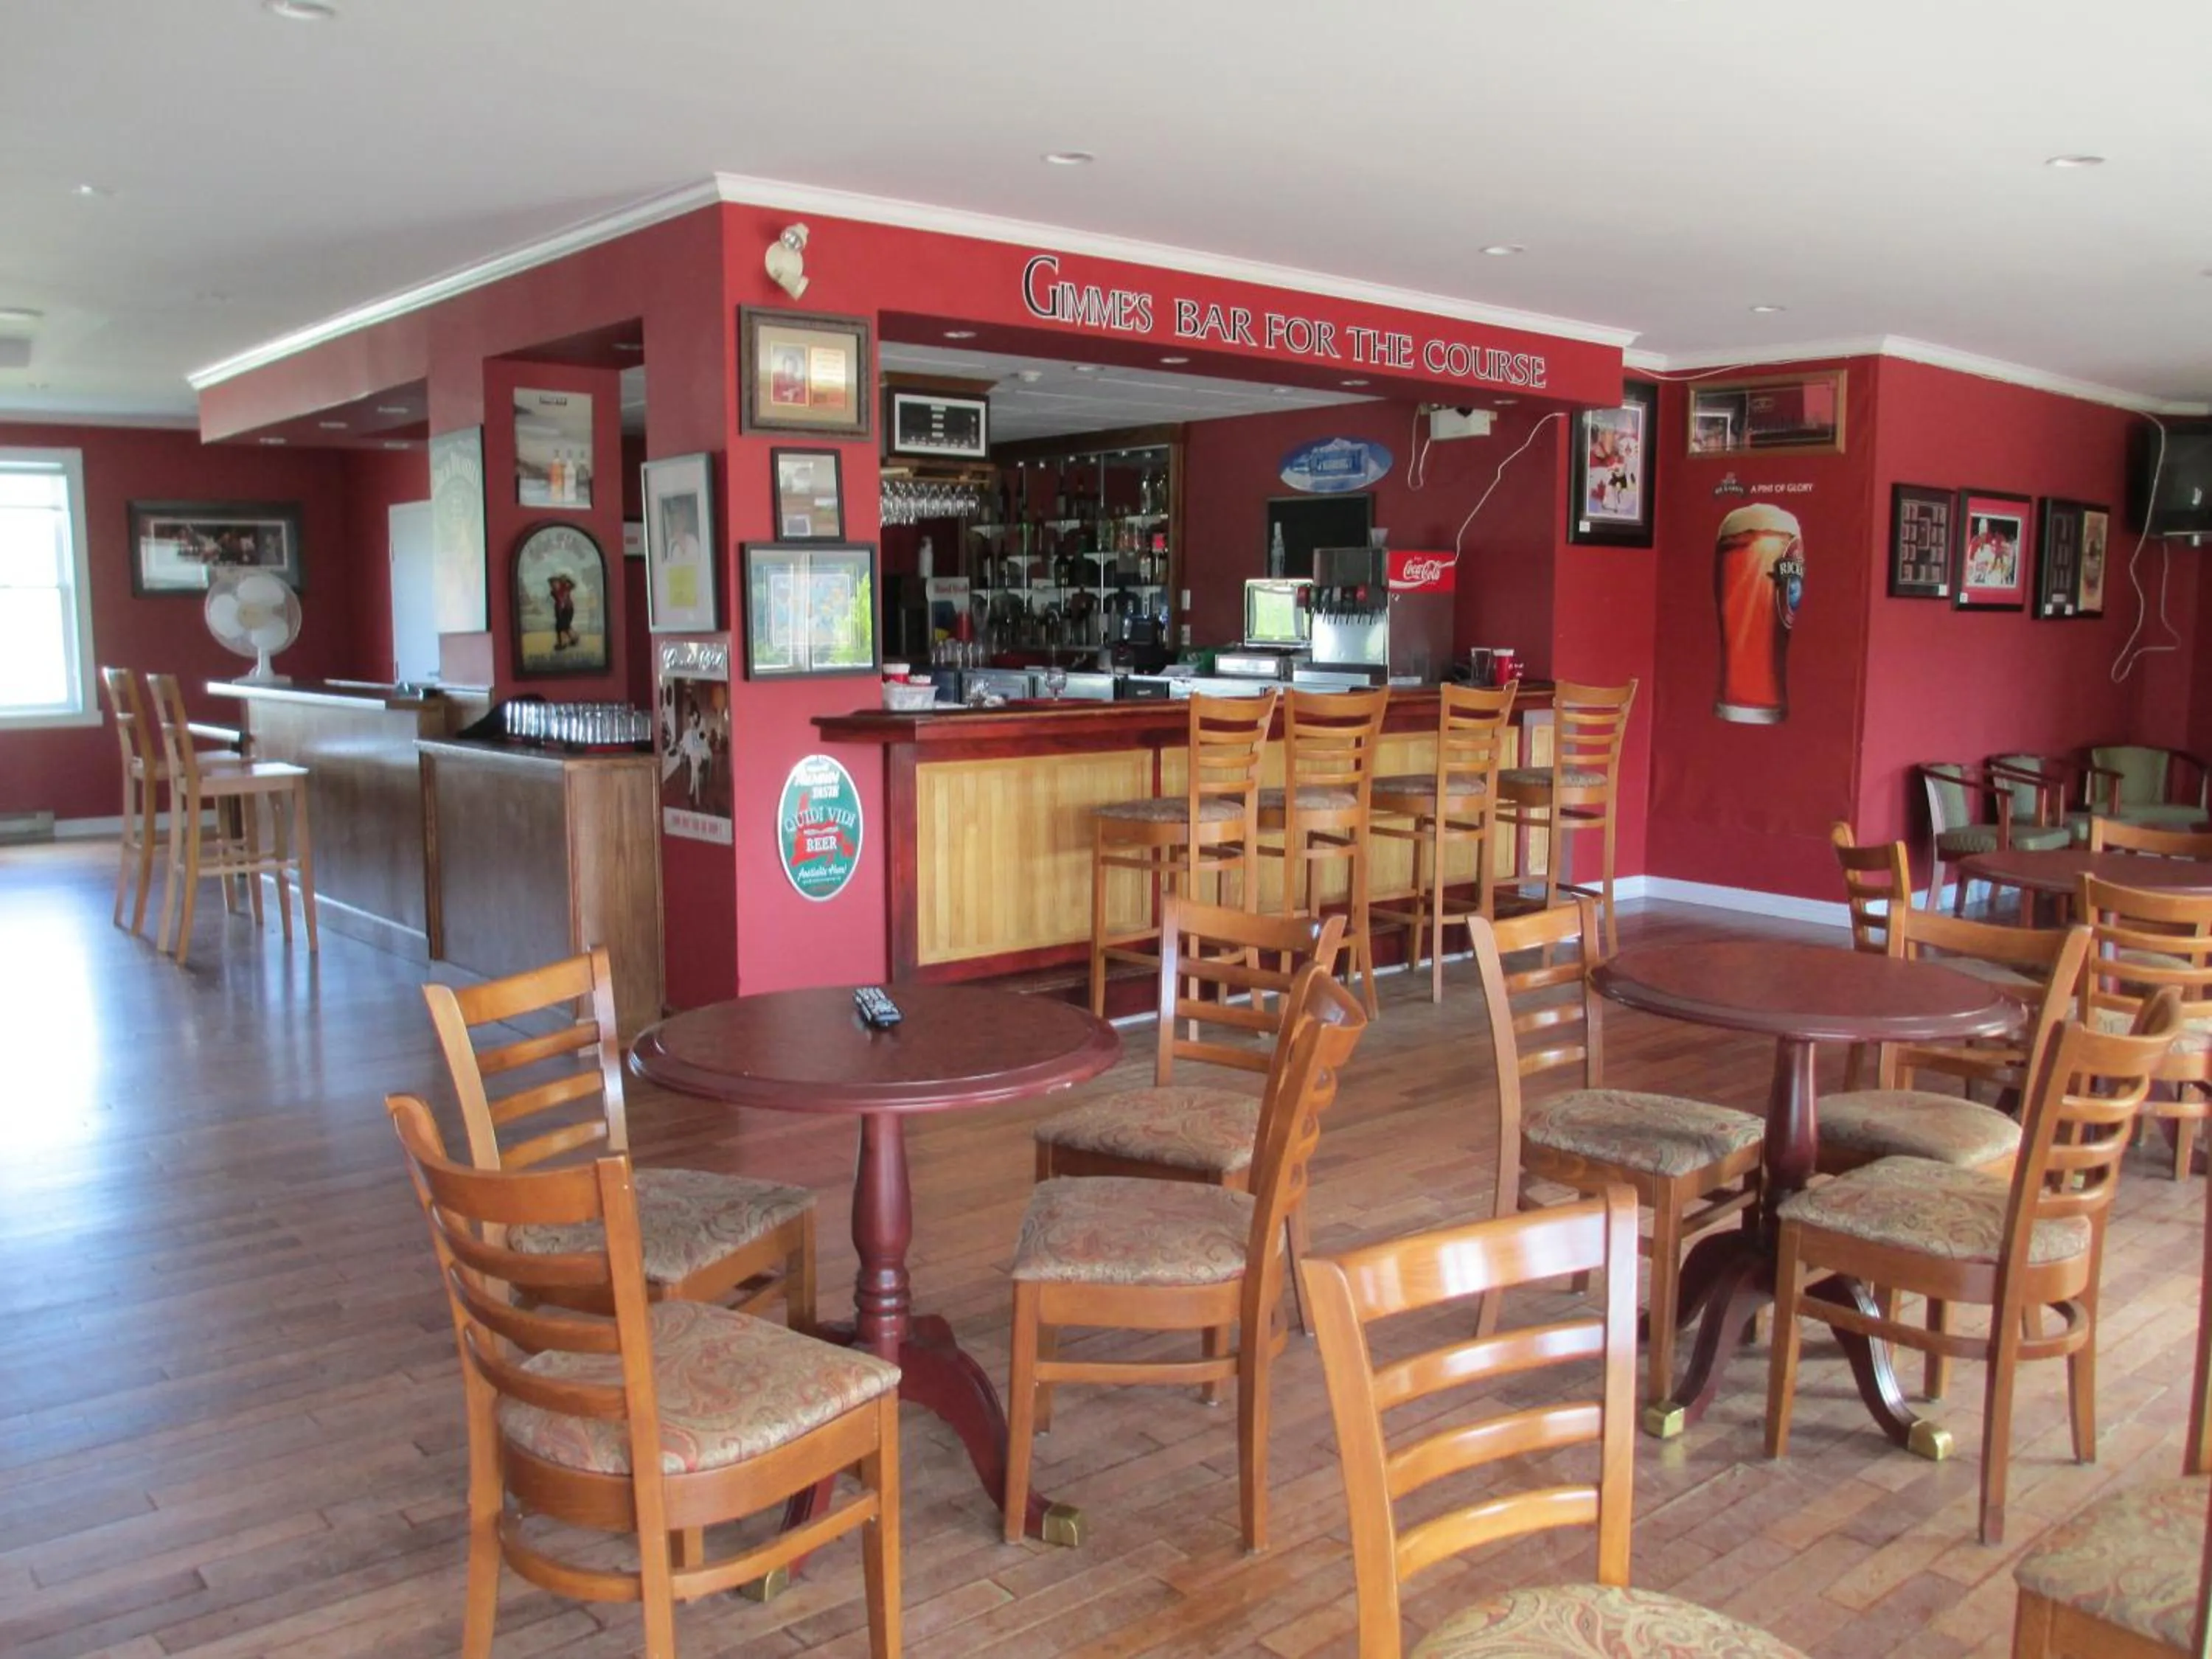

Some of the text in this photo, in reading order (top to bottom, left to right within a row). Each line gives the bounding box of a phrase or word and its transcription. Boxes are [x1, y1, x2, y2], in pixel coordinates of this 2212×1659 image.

[1174, 298, 1258, 347] BAR
[1265, 312, 1341, 359] FOR
[1346, 326, 1414, 369] THE
[1423, 338, 1547, 389] COURSE
[1750, 484, 1756, 493] A
[1757, 484, 1773, 493] PINT
[1774, 484, 1785, 493] OF
[1787, 483, 1813, 493] GLORY
[785, 806, 855, 832] QUIDI VIDI
[806, 835, 838, 852] BEER
